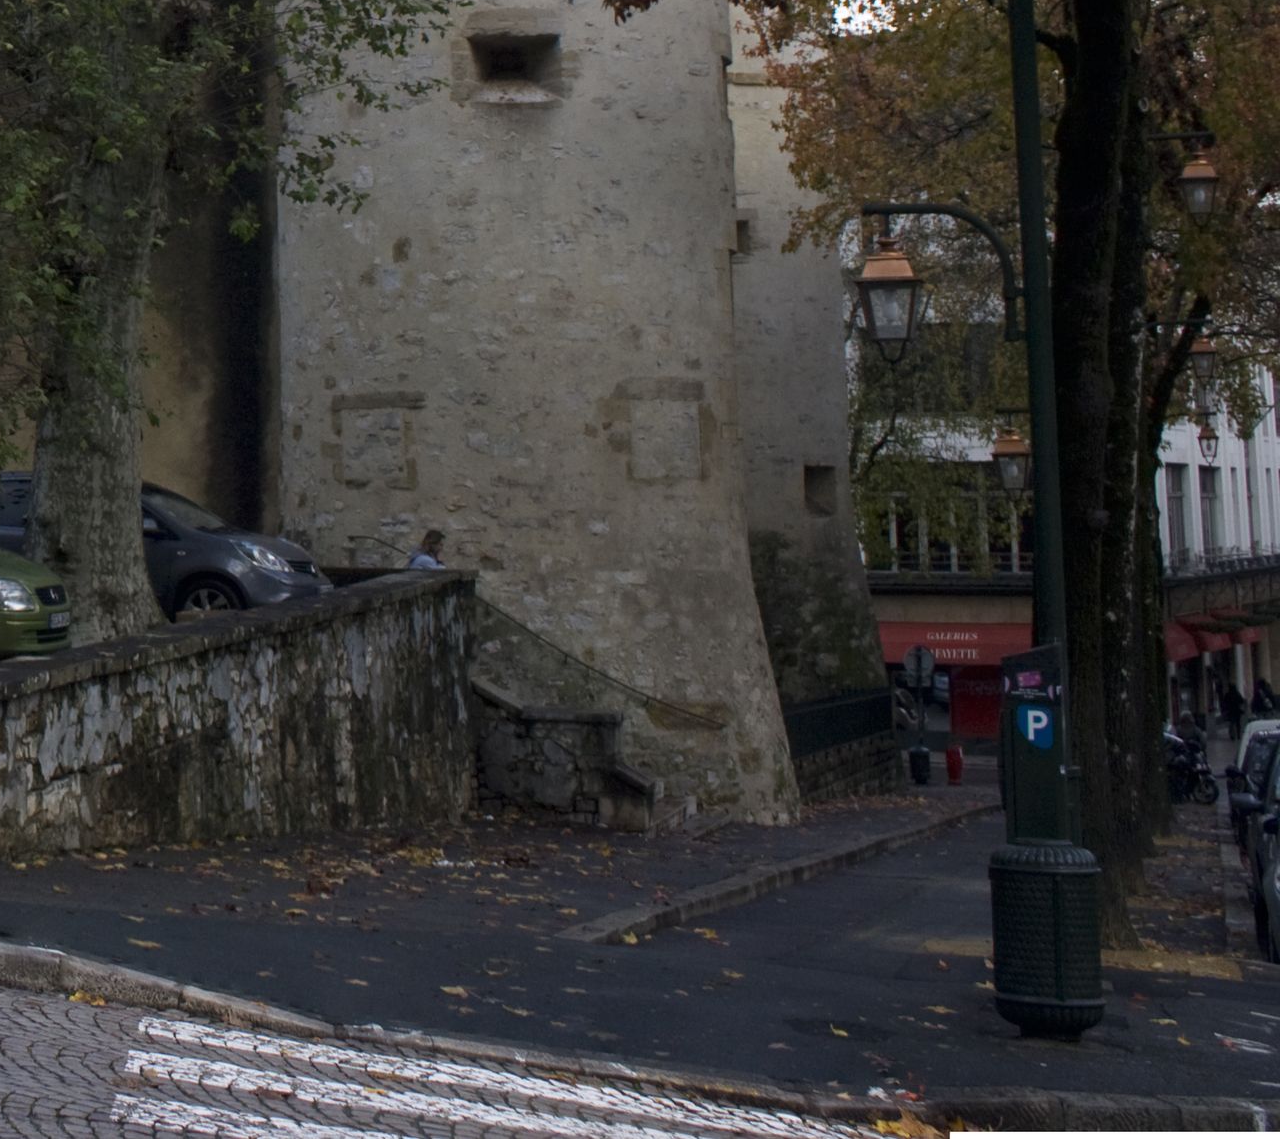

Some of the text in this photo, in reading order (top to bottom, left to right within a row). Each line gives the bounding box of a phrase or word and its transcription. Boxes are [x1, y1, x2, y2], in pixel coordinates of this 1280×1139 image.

[927, 632, 978, 641] GALERIES
[930, 648, 979, 660] FAYETTE
[1027, 709, 1049, 741] P
